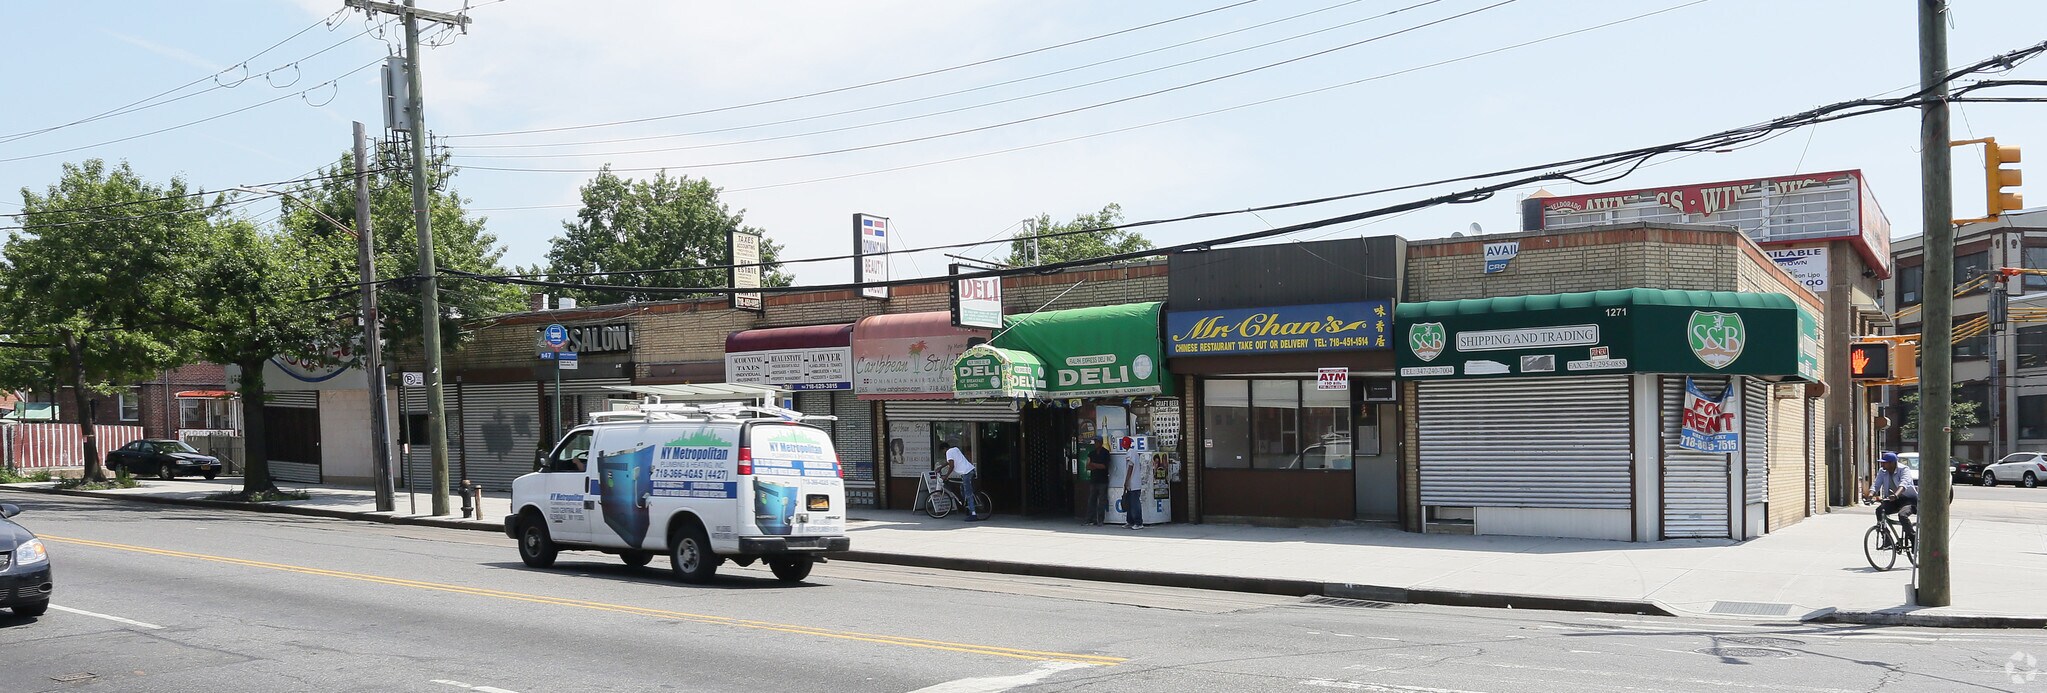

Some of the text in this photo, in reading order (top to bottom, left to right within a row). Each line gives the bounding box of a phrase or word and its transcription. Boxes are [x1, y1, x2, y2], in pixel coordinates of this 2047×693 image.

[1585, 190, 1683, 213] AWNGS
[738, 236, 754, 245] TAXES
[1766, 249, 1821, 258] ILABLE
[738, 267, 757, 275] ESTATE
[865, 259, 884, 275] BEAUTY
[960, 277, 999, 302] DELI
[1605, 307, 1627, 317] 1271
[1172, 312, 1367, 342] Mr. Chan's
[569, 324, 627, 352] SALON
[1175, 336, 1369, 352] CHINESE RESTAURANT TAKE OUT OR DELIVERY TEL: 718-451-1514
[1413, 332, 1443, 351] S&B
[1460, 329, 1594, 347] SHIPPING AND TRADING
[1693, 324, 1740, 352] S&B
[812, 352, 841, 362] LAWYER
[857, 355, 908, 374] Caribbean
[959, 365, 999, 377] DELI
[1058, 366, 1129, 386] DELI
[1010, 375, 1036, 388] DELI
[1682, 408, 1735, 434] RENT
[661, 447, 729, 461] NY Metropolitan
[769, 442, 823, 455] NY Metropolitan
[656, 469, 728, 481] 718-366-4GAS (4427)
[556, 493, 584, 501] Metropolitan
